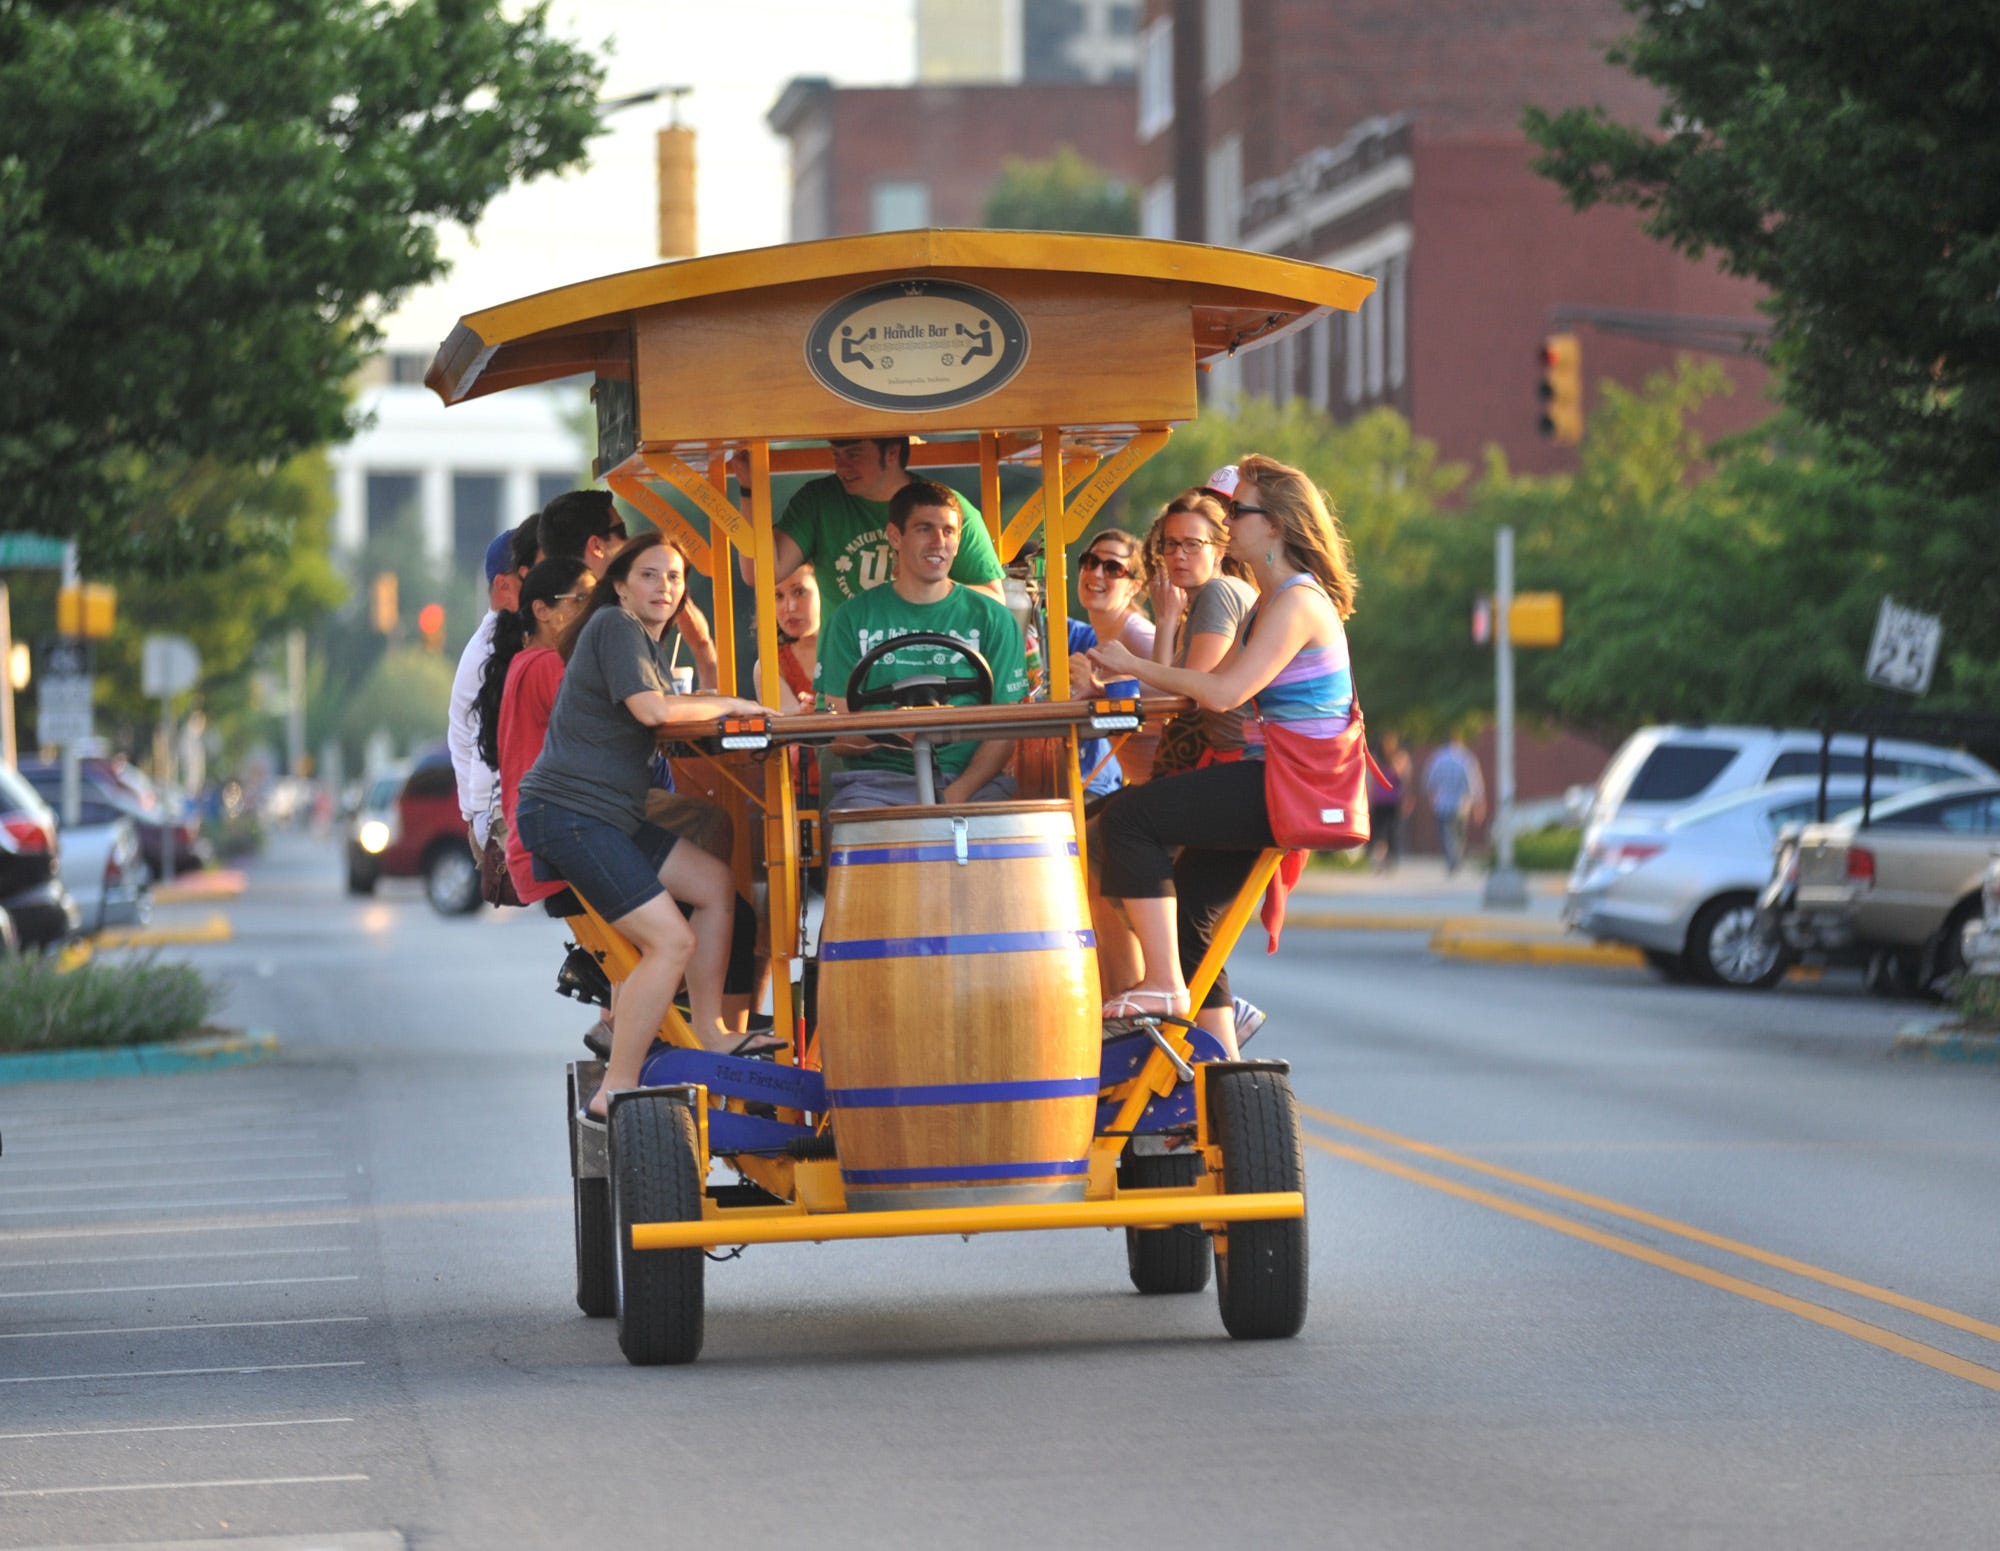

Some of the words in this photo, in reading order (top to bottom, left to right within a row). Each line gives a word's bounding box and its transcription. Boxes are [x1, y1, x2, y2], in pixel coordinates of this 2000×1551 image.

[883, 325, 925, 340] Handle
[928, 323, 949, 338] Bar
[844, 531, 878, 555] MATCH
